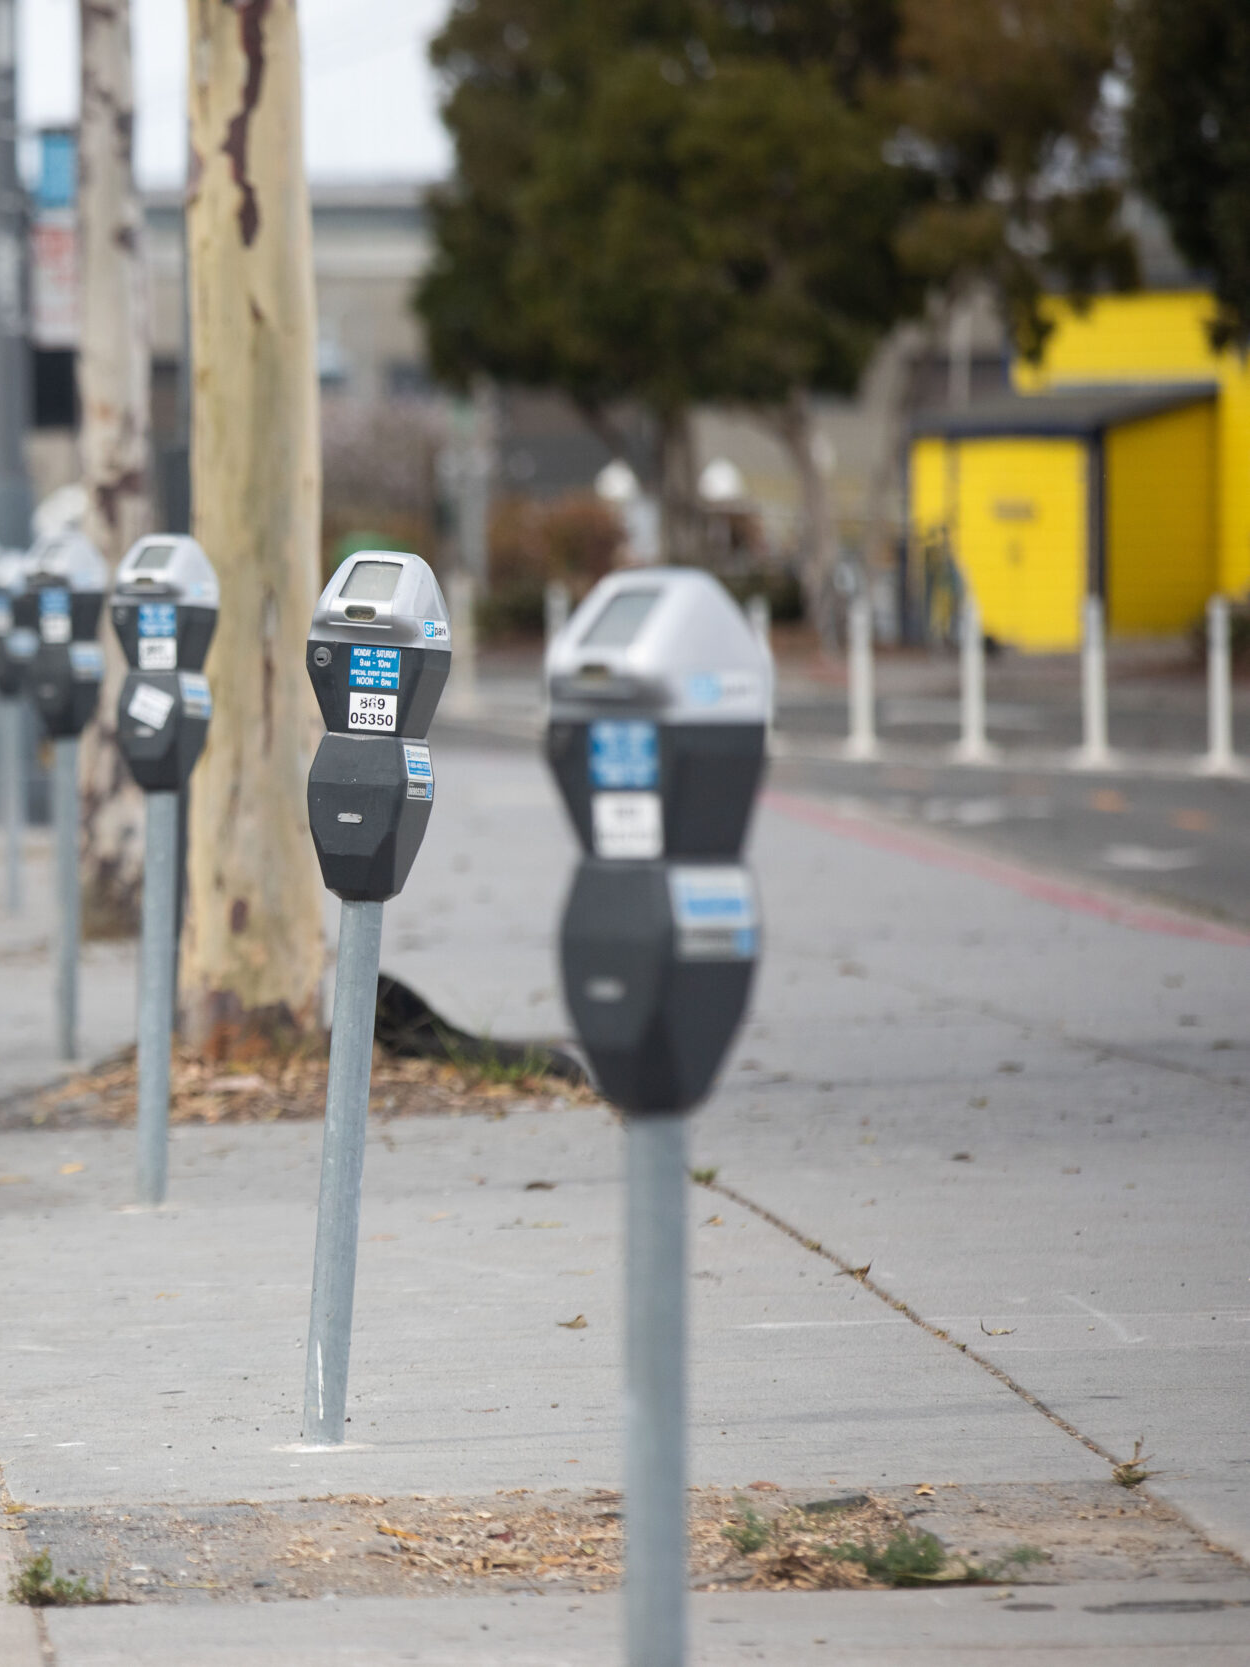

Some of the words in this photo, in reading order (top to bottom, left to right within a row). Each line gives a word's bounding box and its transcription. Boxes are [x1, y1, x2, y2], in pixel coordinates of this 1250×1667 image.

[353, 648, 372, 656] MONDAY
[376, 649, 398, 658] SATURDAY
[359, 658, 371, 667] 9AM
[378, 659, 391, 668] 10PM
[356, 676, 374, 685] NOON
[380, 678, 392, 686] 6PM
[350, 712, 393, 726] 05350
